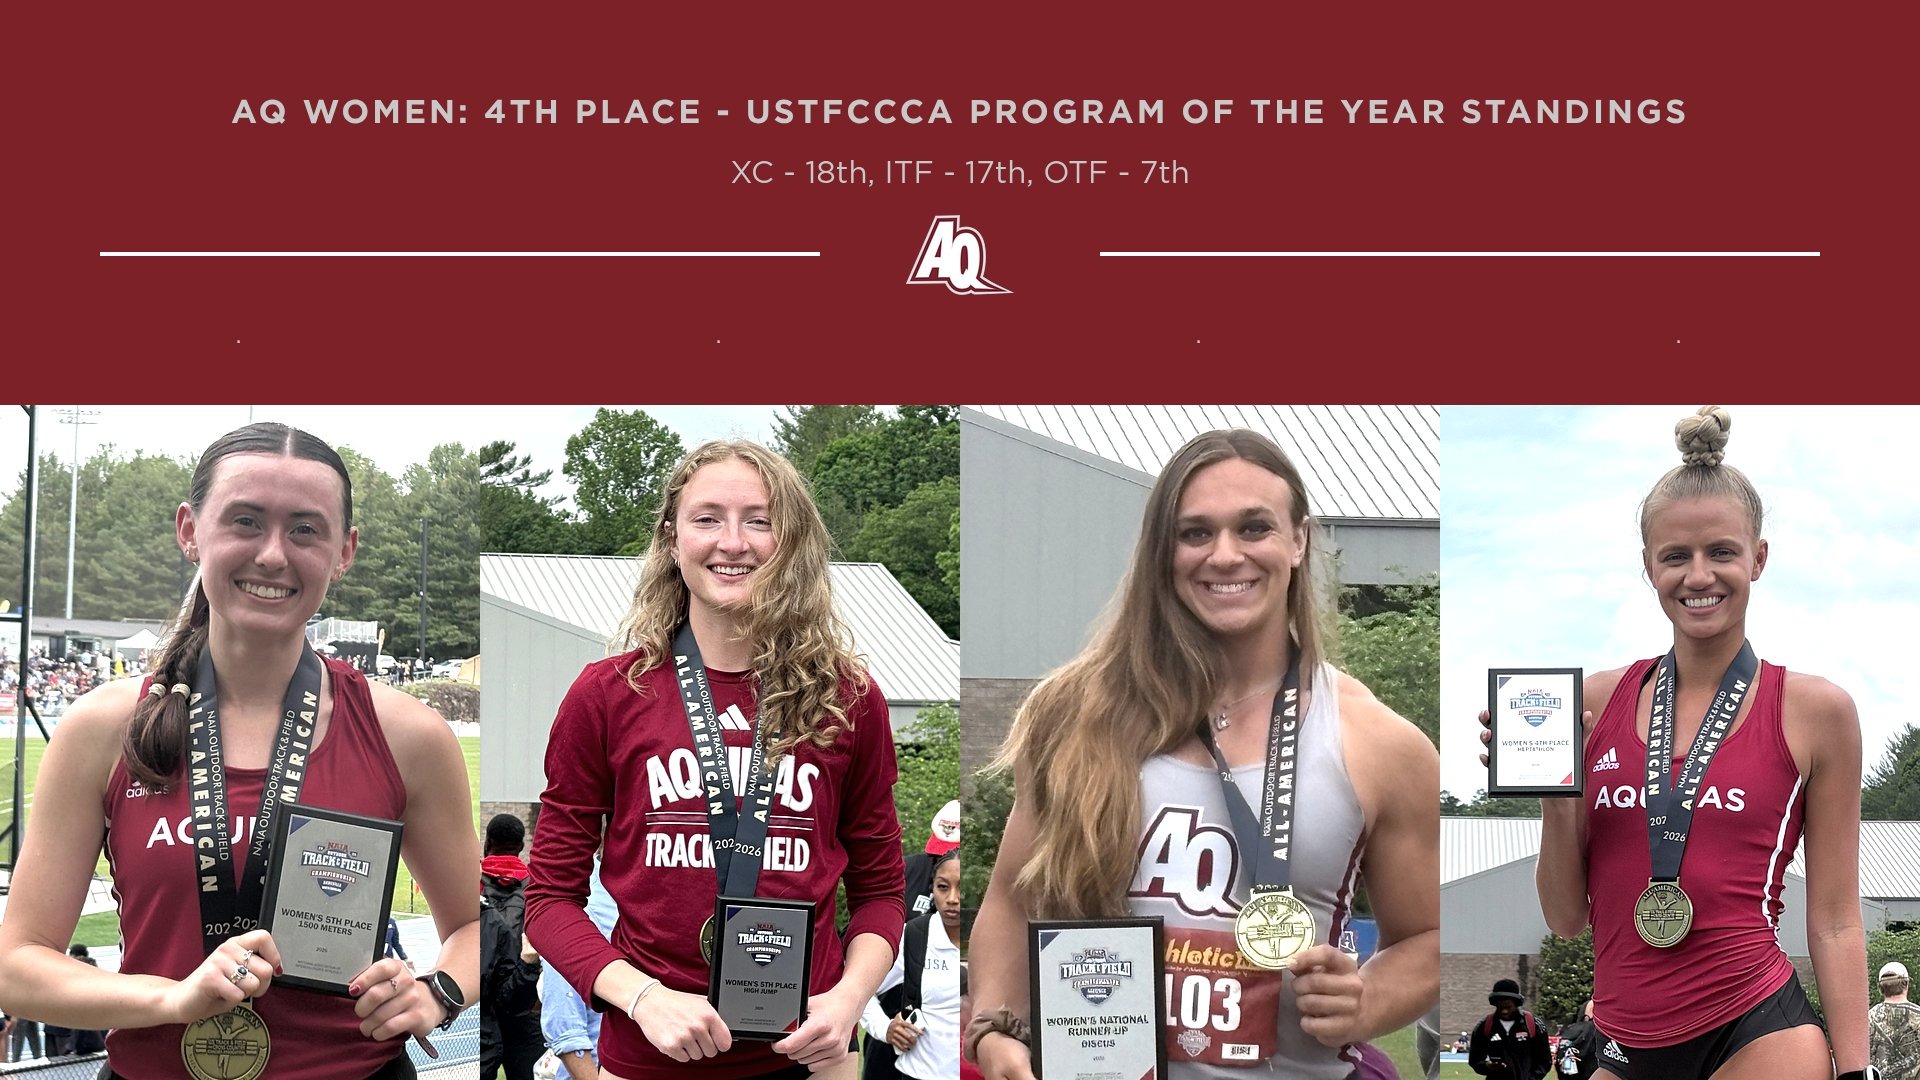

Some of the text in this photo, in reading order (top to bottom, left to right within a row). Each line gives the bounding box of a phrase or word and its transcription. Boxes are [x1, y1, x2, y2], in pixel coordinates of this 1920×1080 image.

[207, 710, 217, 736] NAIA
[675, 655, 723, 816] ALL-AMERICAN
[695, 669, 706, 690] NAIA
[701, 689, 718, 737] OUTDOOR
[710, 733, 725, 760] TRACK
[720, 767, 730, 789] FIELD
[1648, 666, 1667, 796] ALL-AMERICAN
[1678, 770, 1690, 788] NAIA
[1685, 735, 1705, 770] OUTDOOR
[1701, 715, 1715, 736] TRACK
[1716, 691, 1727, 709] FIELD
[1681, 679, 1747, 811] ALL-AMERICAN
[208, 736, 222, 789] OUTDOOR
[1273, 688, 1298, 861] ALL-AMERICAN
[1592, 761, 1620, 772] adidas
[1662, 755, 1670, 774] FIELD
[189, 692, 218, 892] ALL-AMERICAN
[252, 830, 267, 856] NAIA
[260, 774, 280, 828] OUTDOOR
[273, 744, 288, 776] TRACK
[282, 710, 296, 735] FIELD
[747, 773, 758, 796] NAIA
[213, 788, 226, 822] TRACK
[1594, 785, 1746, 812] AQAS
[217, 831, 229, 861] FIELD
[715, 838, 735, 850] 202
[1663, 831, 1686, 842] 2026
[645, 833, 810, 872] TRACK IELD
[734, 843, 762, 857] 2026
[1127, 803, 1243, 919] AQ
[206, 922, 231, 936] 202
[233, 916, 258, 931] 202
[281, 908, 372, 931] WOMEN'S 5TH PLACE
[298, 920, 353, 936] 1500 METERS
[725, 979, 759, 988] WOMEN'S
[775, 982, 797, 990] PLACE
[1046, 1014, 1149, 1026] WOMEN'S NATIONAL
[1081, 1039, 1116, 1048] DISCUS
[1603, 1048, 1629, 1064] adidas
